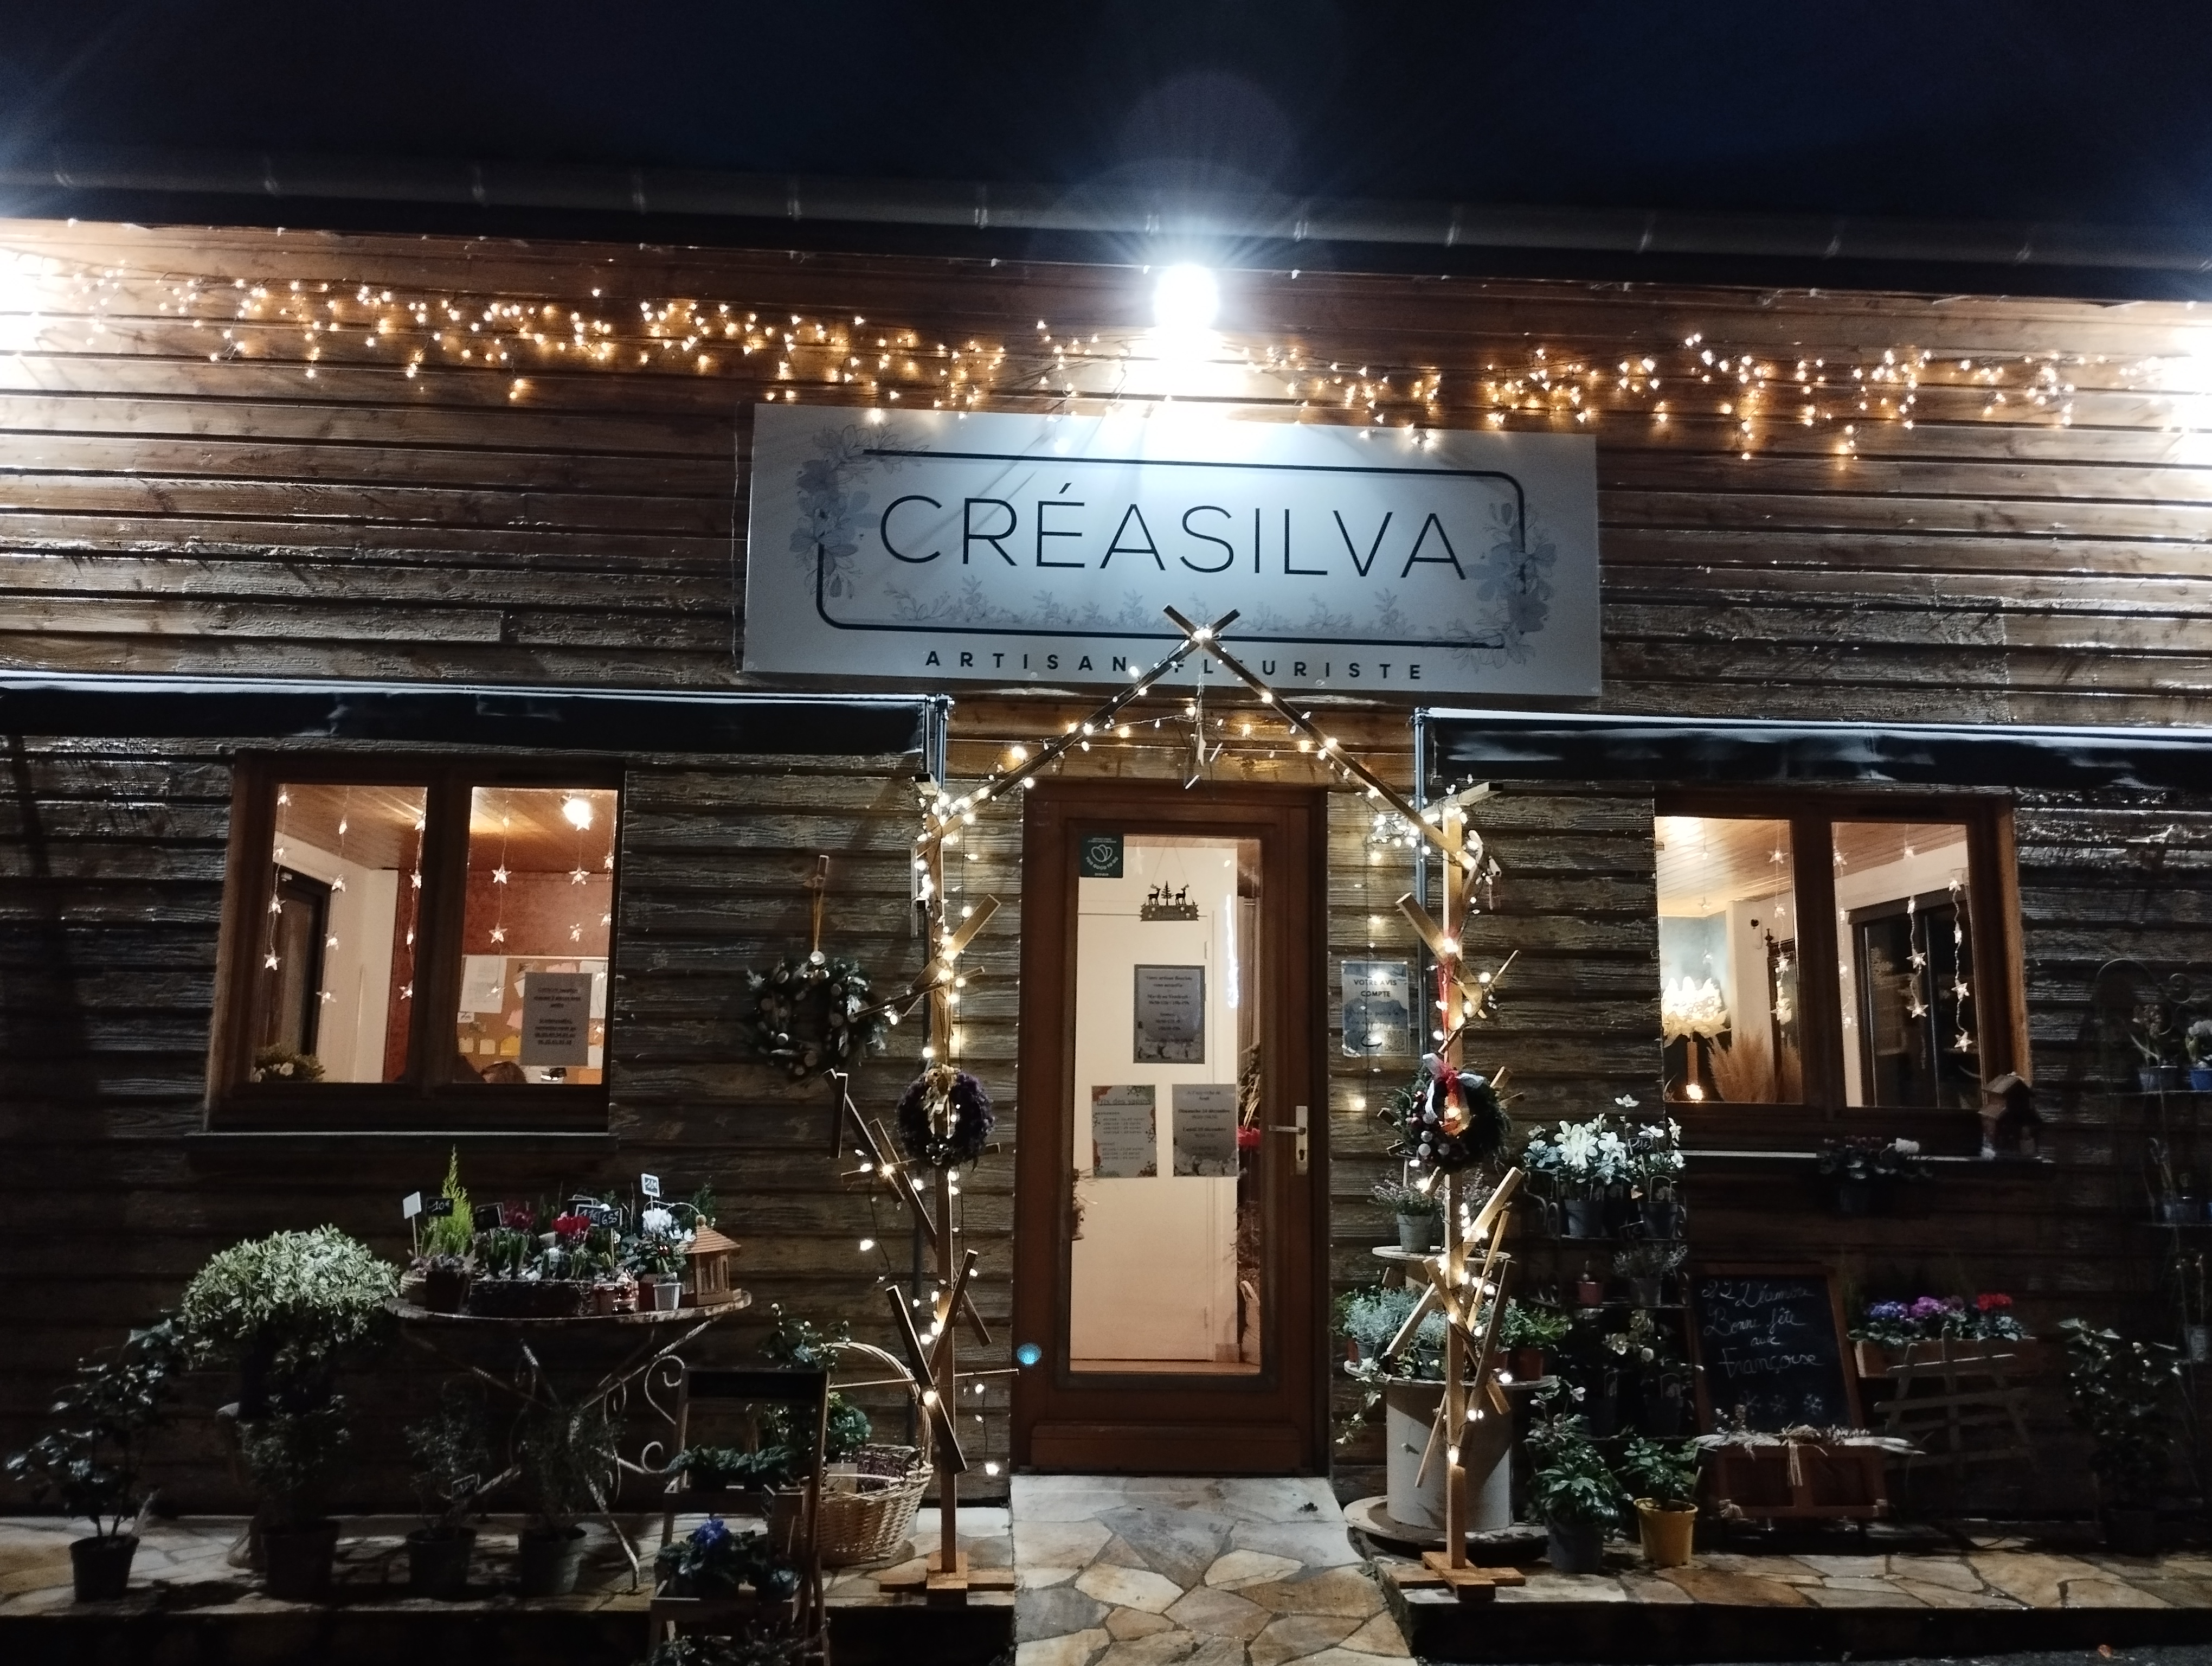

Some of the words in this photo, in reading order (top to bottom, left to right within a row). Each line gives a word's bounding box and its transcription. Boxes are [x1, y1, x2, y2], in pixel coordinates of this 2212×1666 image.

[880, 482, 1466, 580] CRÉASILVA
[925, 650, 1127, 672] ARTISAN
[1174, 658, 1422, 680] FLURISTE
[428, 1200, 451, 1213] 10€
[1703, 1303, 1761, 1336] Bonne
[1762, 1306, 1806, 1335] fête
